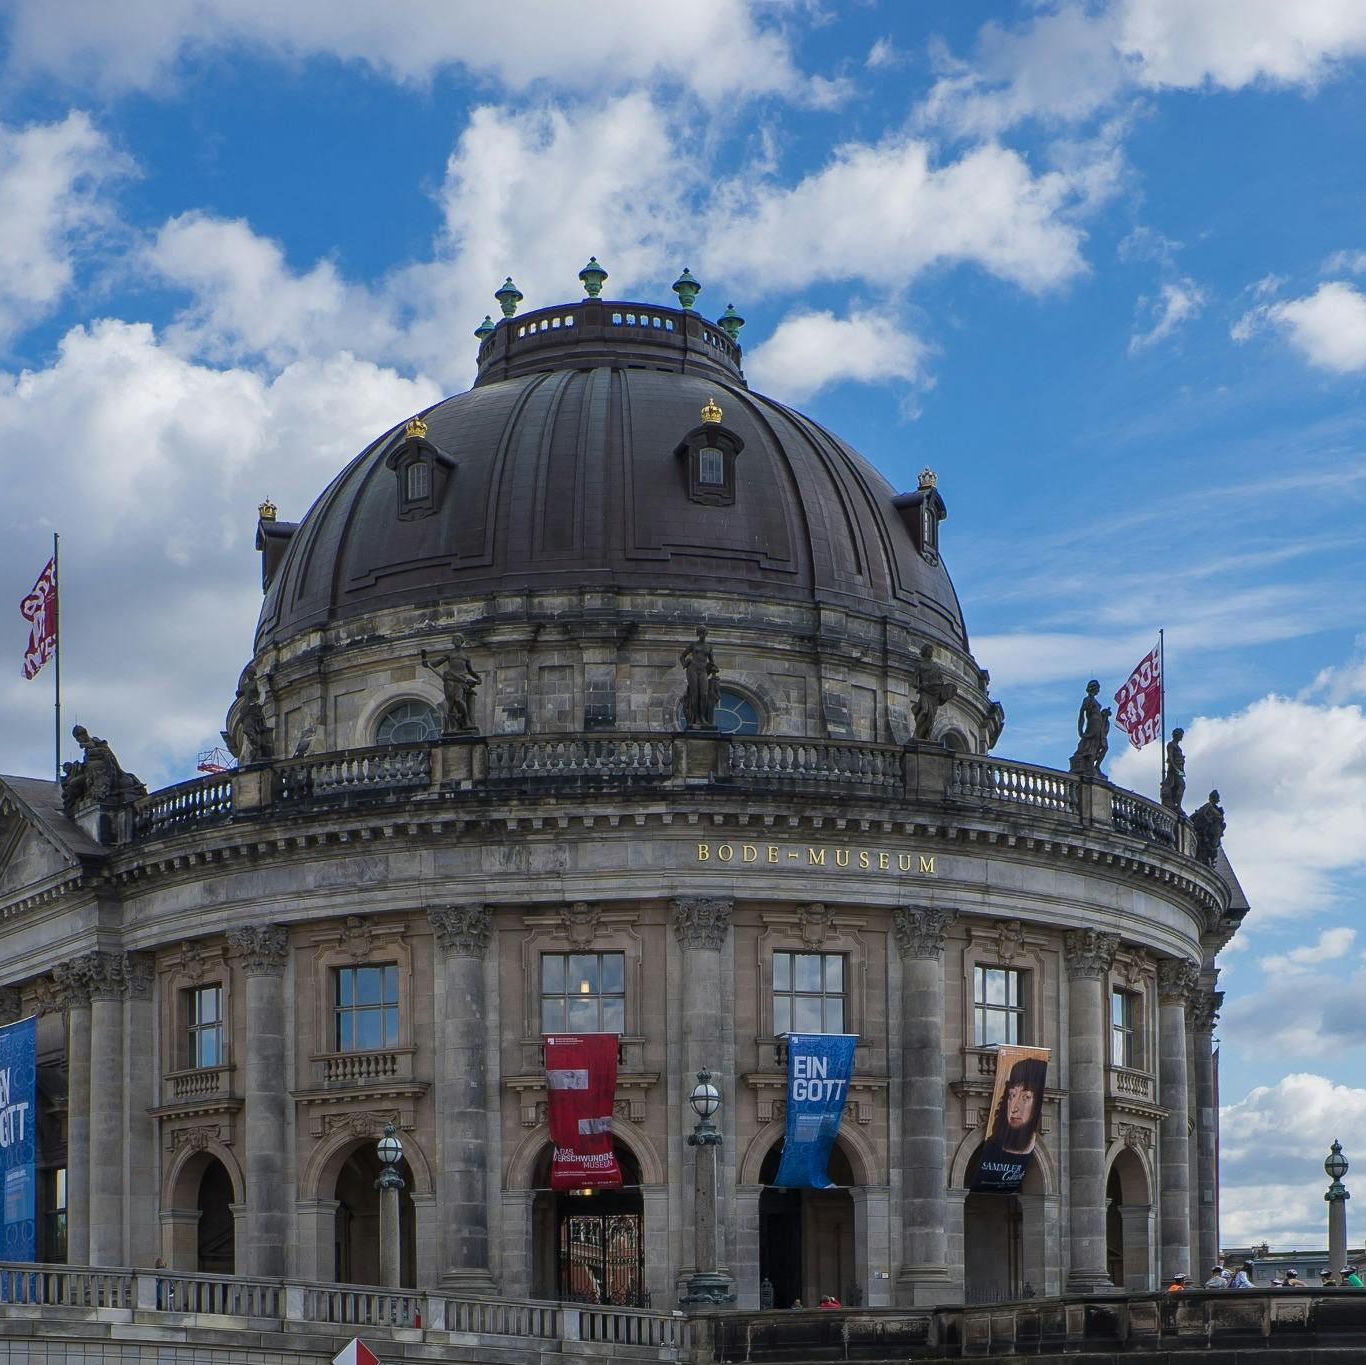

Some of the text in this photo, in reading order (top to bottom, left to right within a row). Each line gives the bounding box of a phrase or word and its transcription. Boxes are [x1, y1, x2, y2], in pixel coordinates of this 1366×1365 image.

[698, 843, 935, 873] BODE-MUSEUM
[794, 1055, 827, 1079] EIN
[792, 1079, 846, 1102] GOTT
